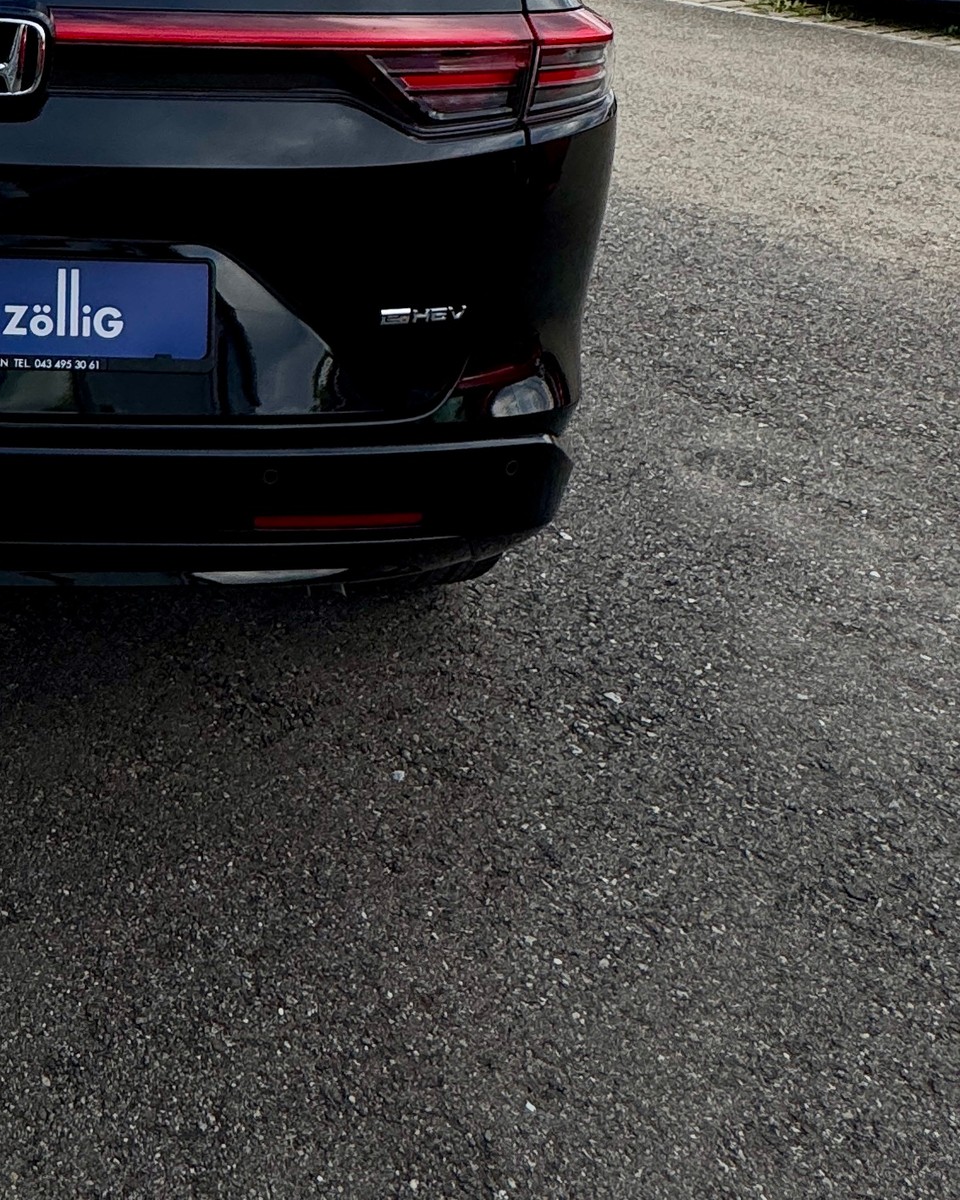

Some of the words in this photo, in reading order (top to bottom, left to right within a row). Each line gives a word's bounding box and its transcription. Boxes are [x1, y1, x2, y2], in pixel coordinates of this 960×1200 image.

[34, 358, 52, 369] 043
[54, 359, 72, 369] 495
[74, 360, 87, 370] 30
[88, 360, 100, 370] 61
